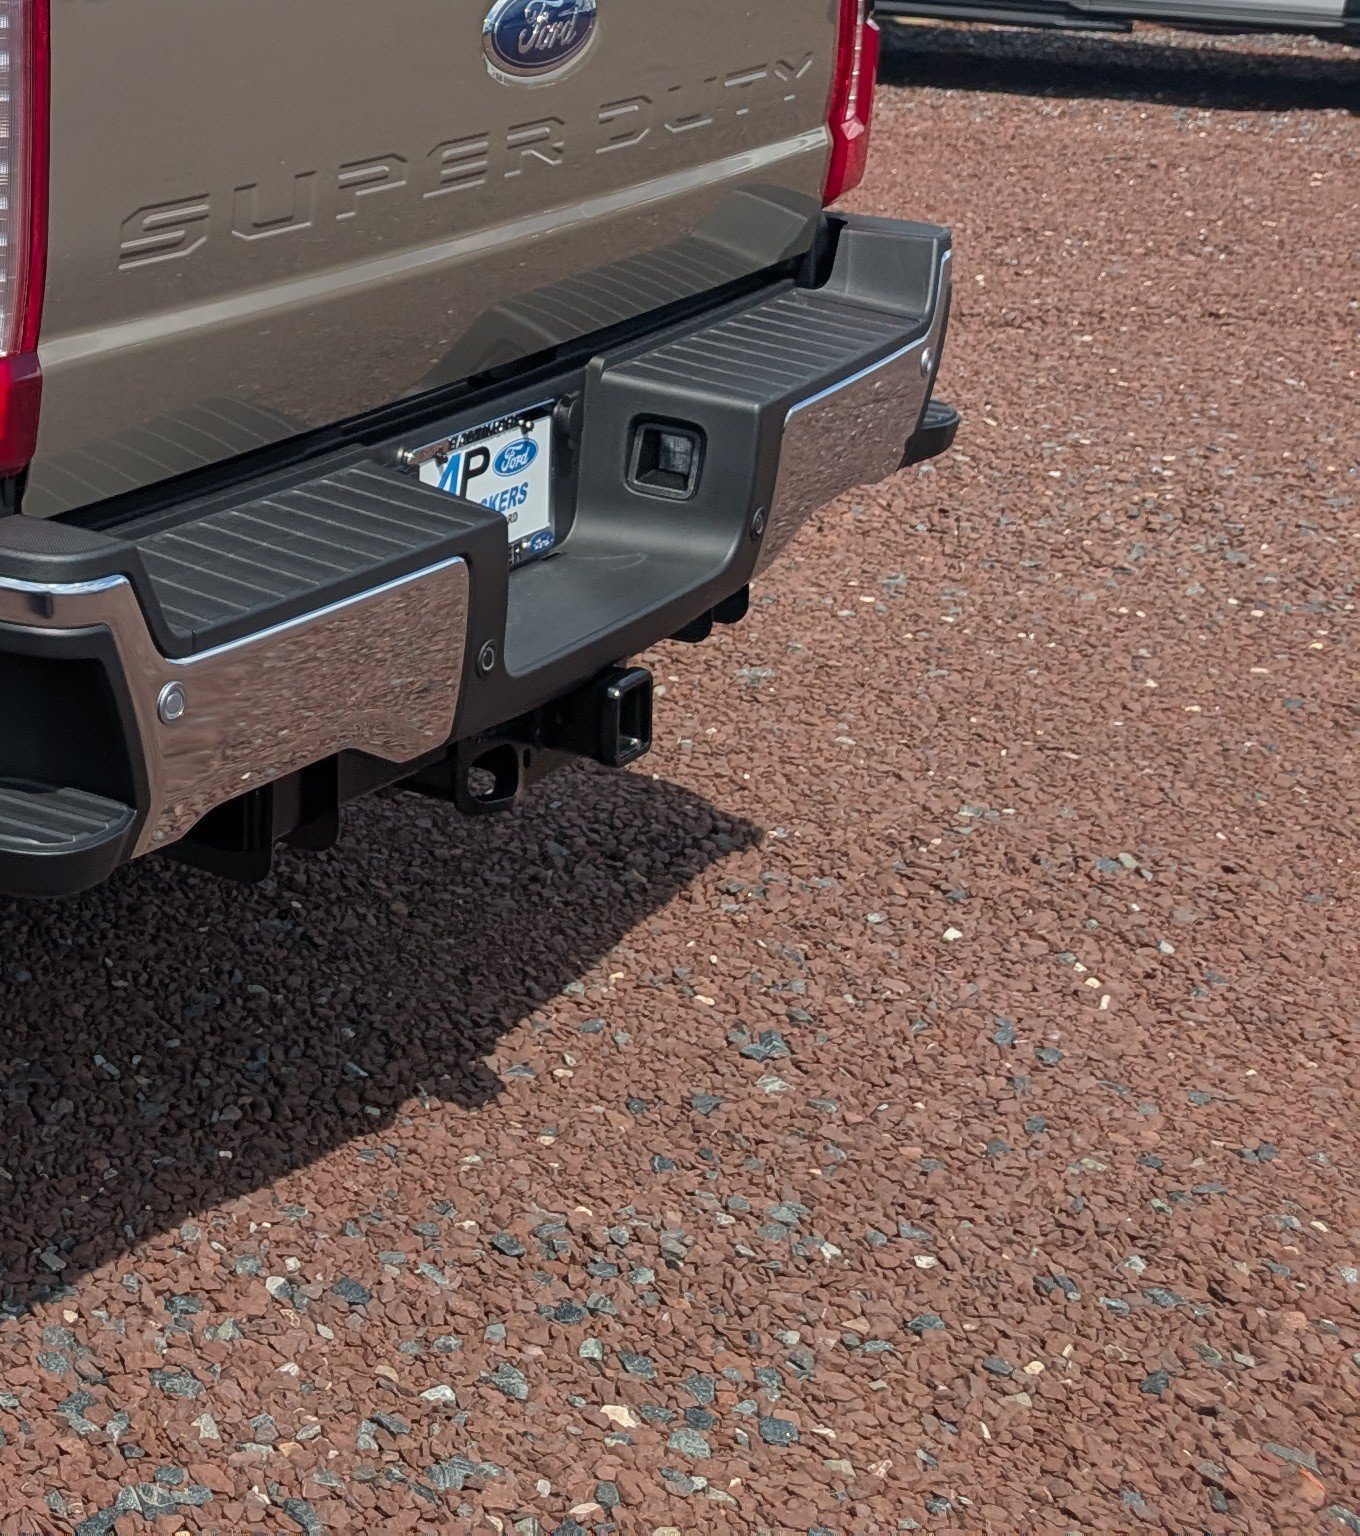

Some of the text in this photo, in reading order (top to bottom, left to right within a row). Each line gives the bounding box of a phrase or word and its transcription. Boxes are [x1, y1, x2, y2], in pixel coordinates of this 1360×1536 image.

[118, 51, 813, 270] SUPER DUTY
[507, 511, 519, 524] RD
